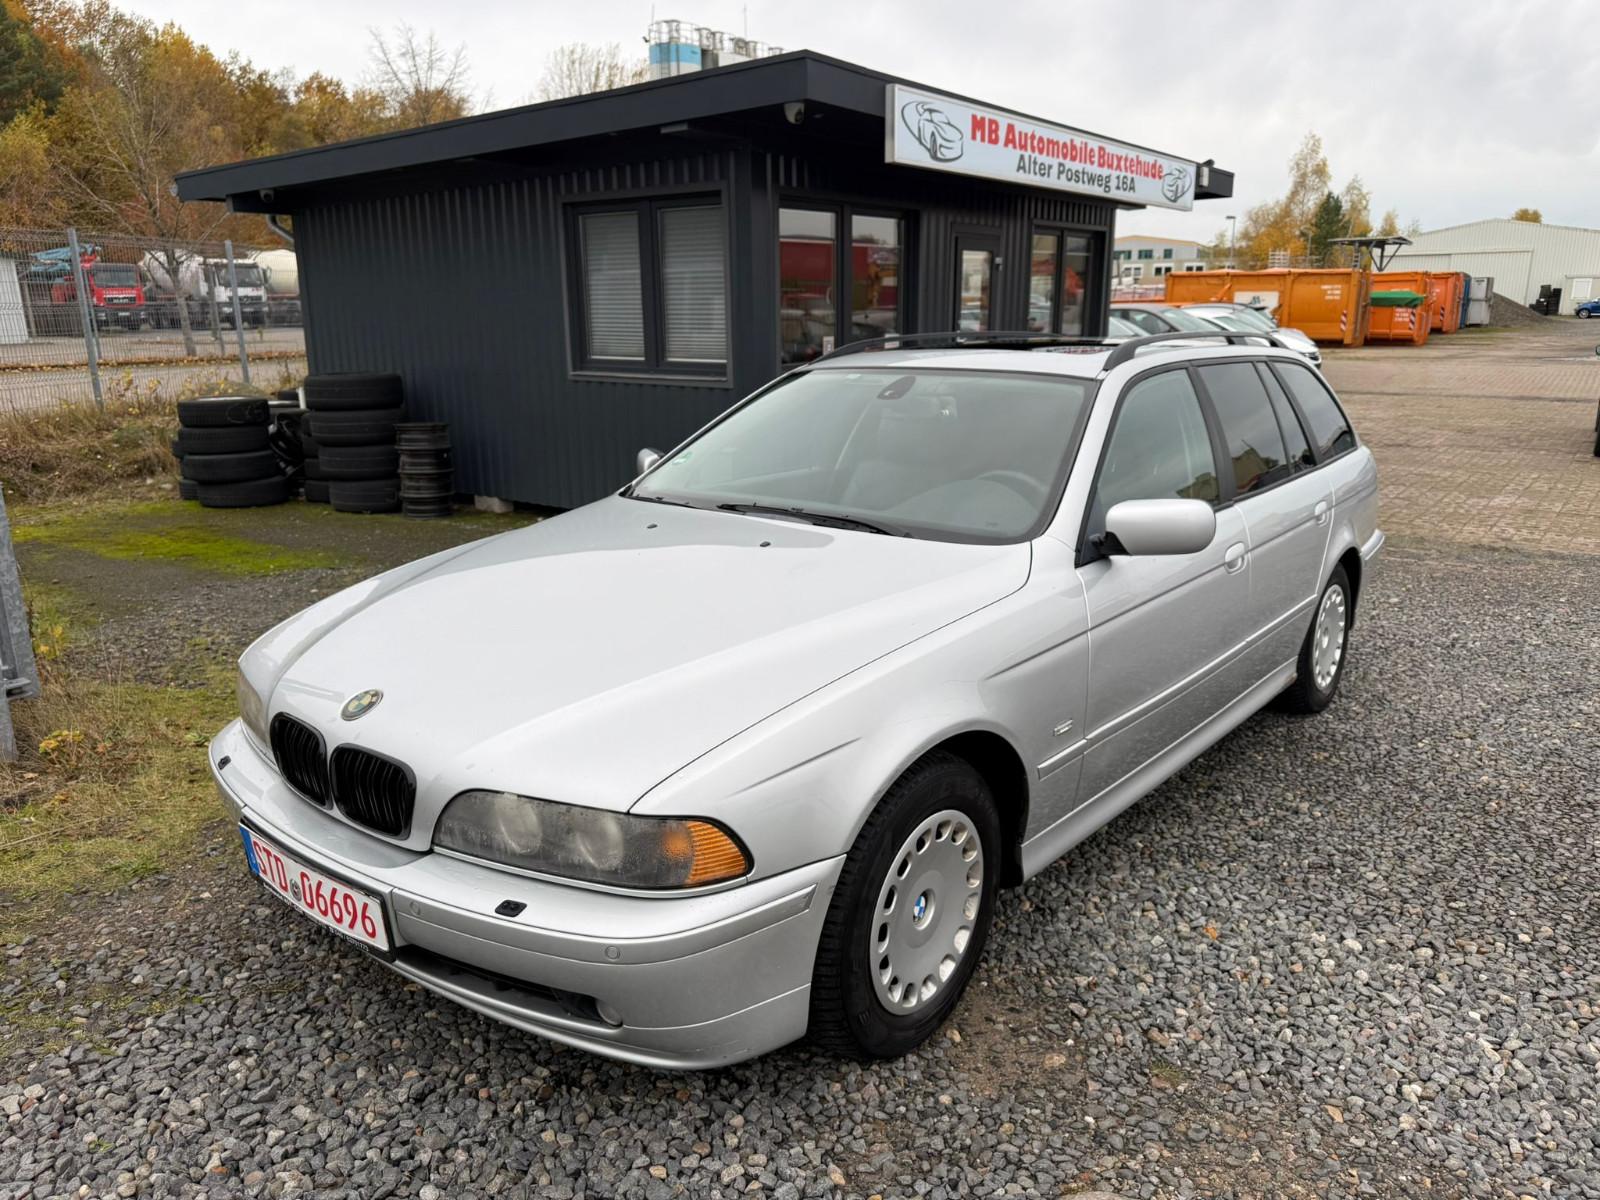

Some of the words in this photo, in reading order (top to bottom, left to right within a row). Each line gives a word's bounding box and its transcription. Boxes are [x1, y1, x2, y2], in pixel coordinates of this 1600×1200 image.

[971, 114, 999, 145] MB
[1003, 123, 1096, 166] Automobile
[1097, 145, 1164, 180] Buxtehude
[1016, 154, 1053, 178] Alter
[1057, 162, 1112, 193] Postweg
[1115, 174, 1136, 193] 16A
[252, 840, 289, 893] STD
[300, 871, 377, 939] 06696
